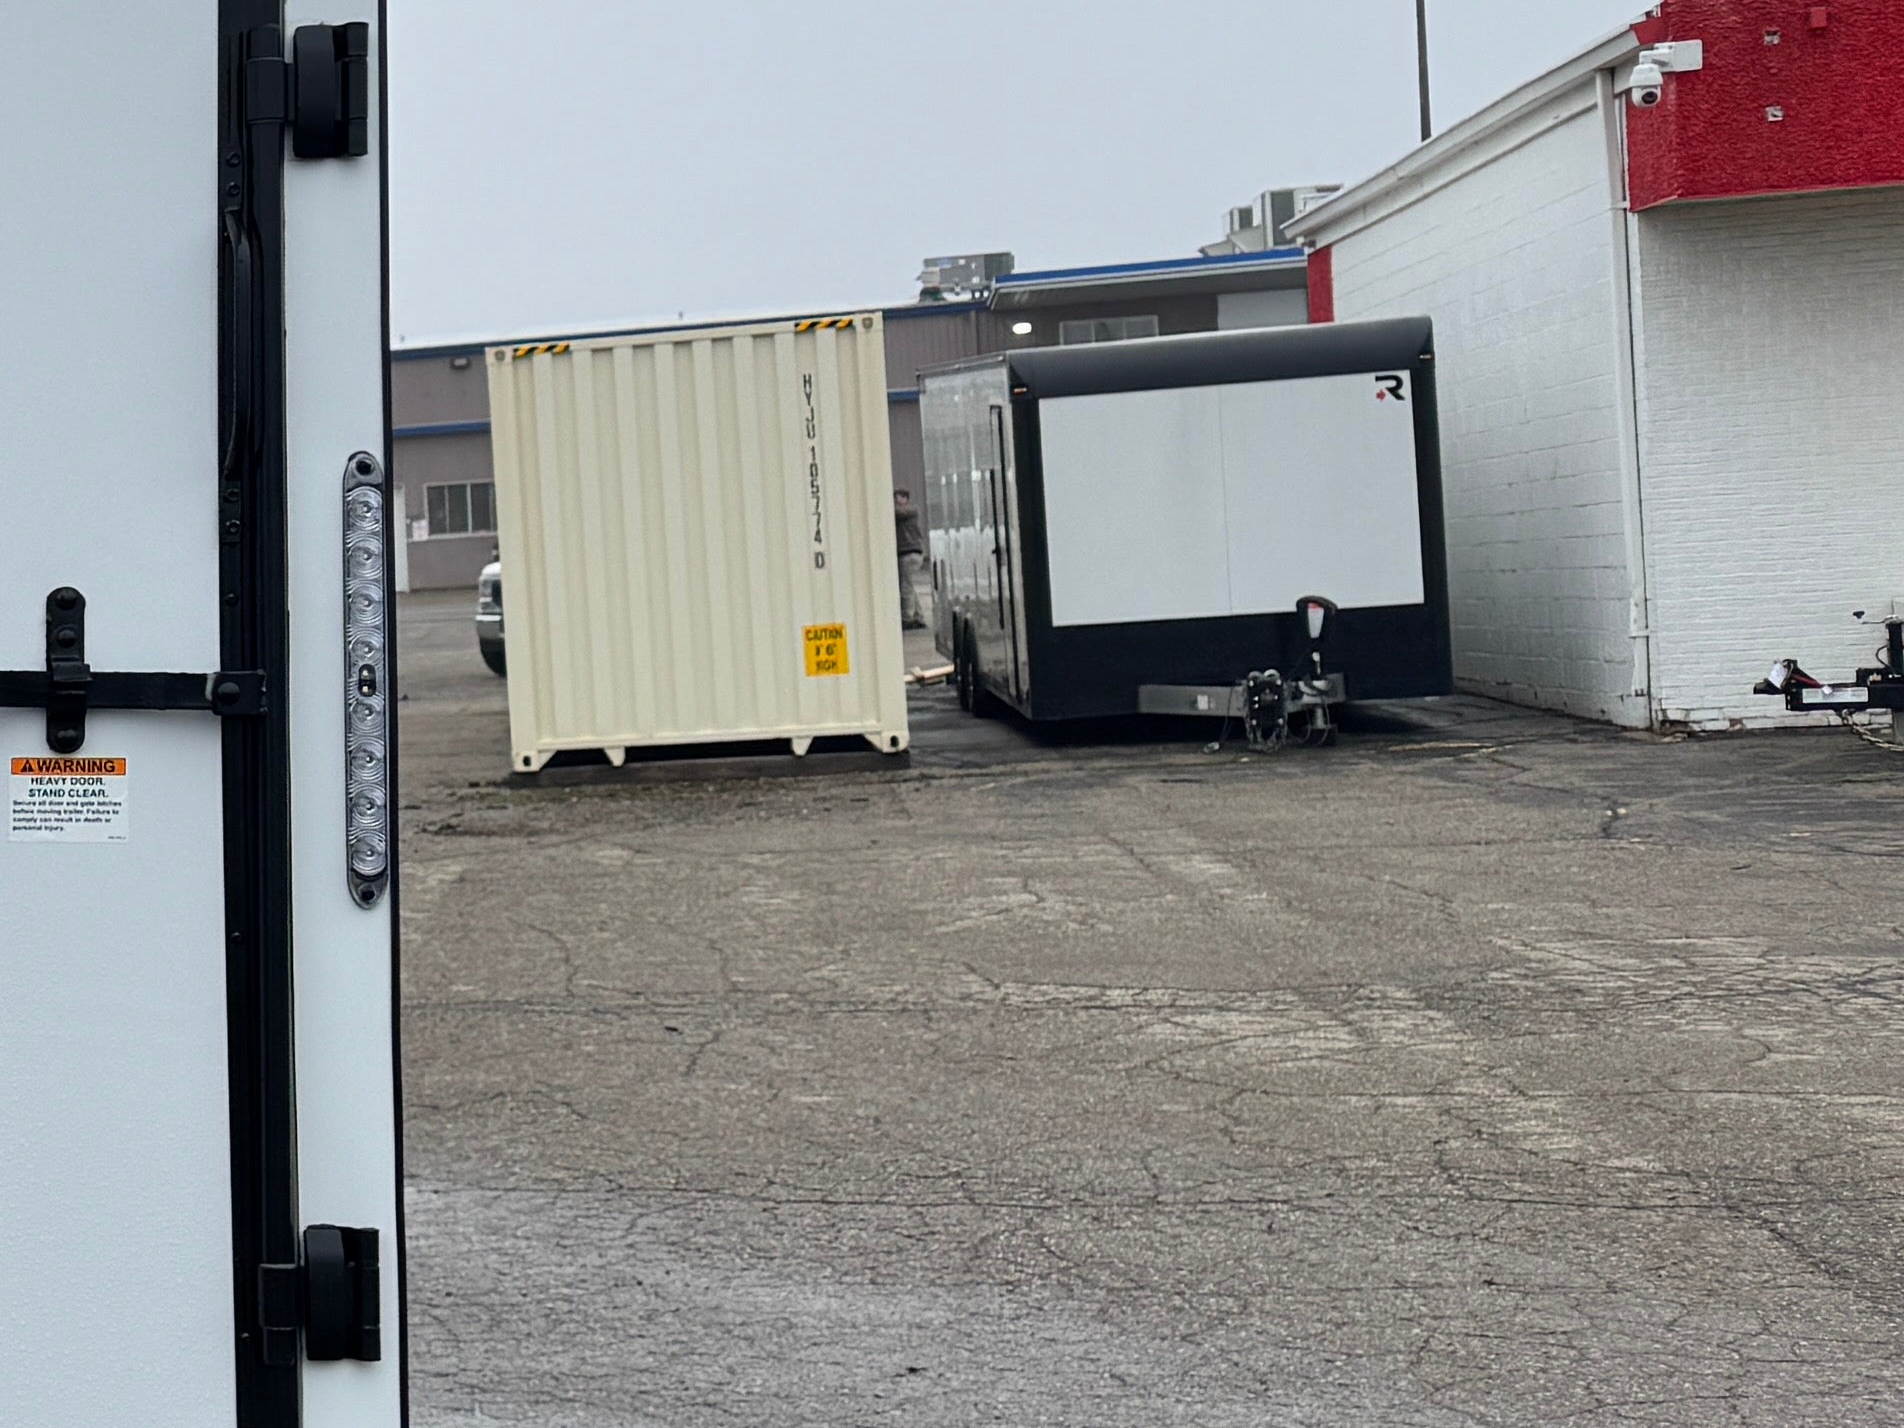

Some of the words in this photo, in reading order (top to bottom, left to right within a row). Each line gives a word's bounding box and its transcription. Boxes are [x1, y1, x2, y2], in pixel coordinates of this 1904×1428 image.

[805, 628, 843, 641] CAUTION
[37, 759, 116, 773] WARNING
[31, 777, 67, 785] HEAVY
[28, 789, 66, 797] STAND
